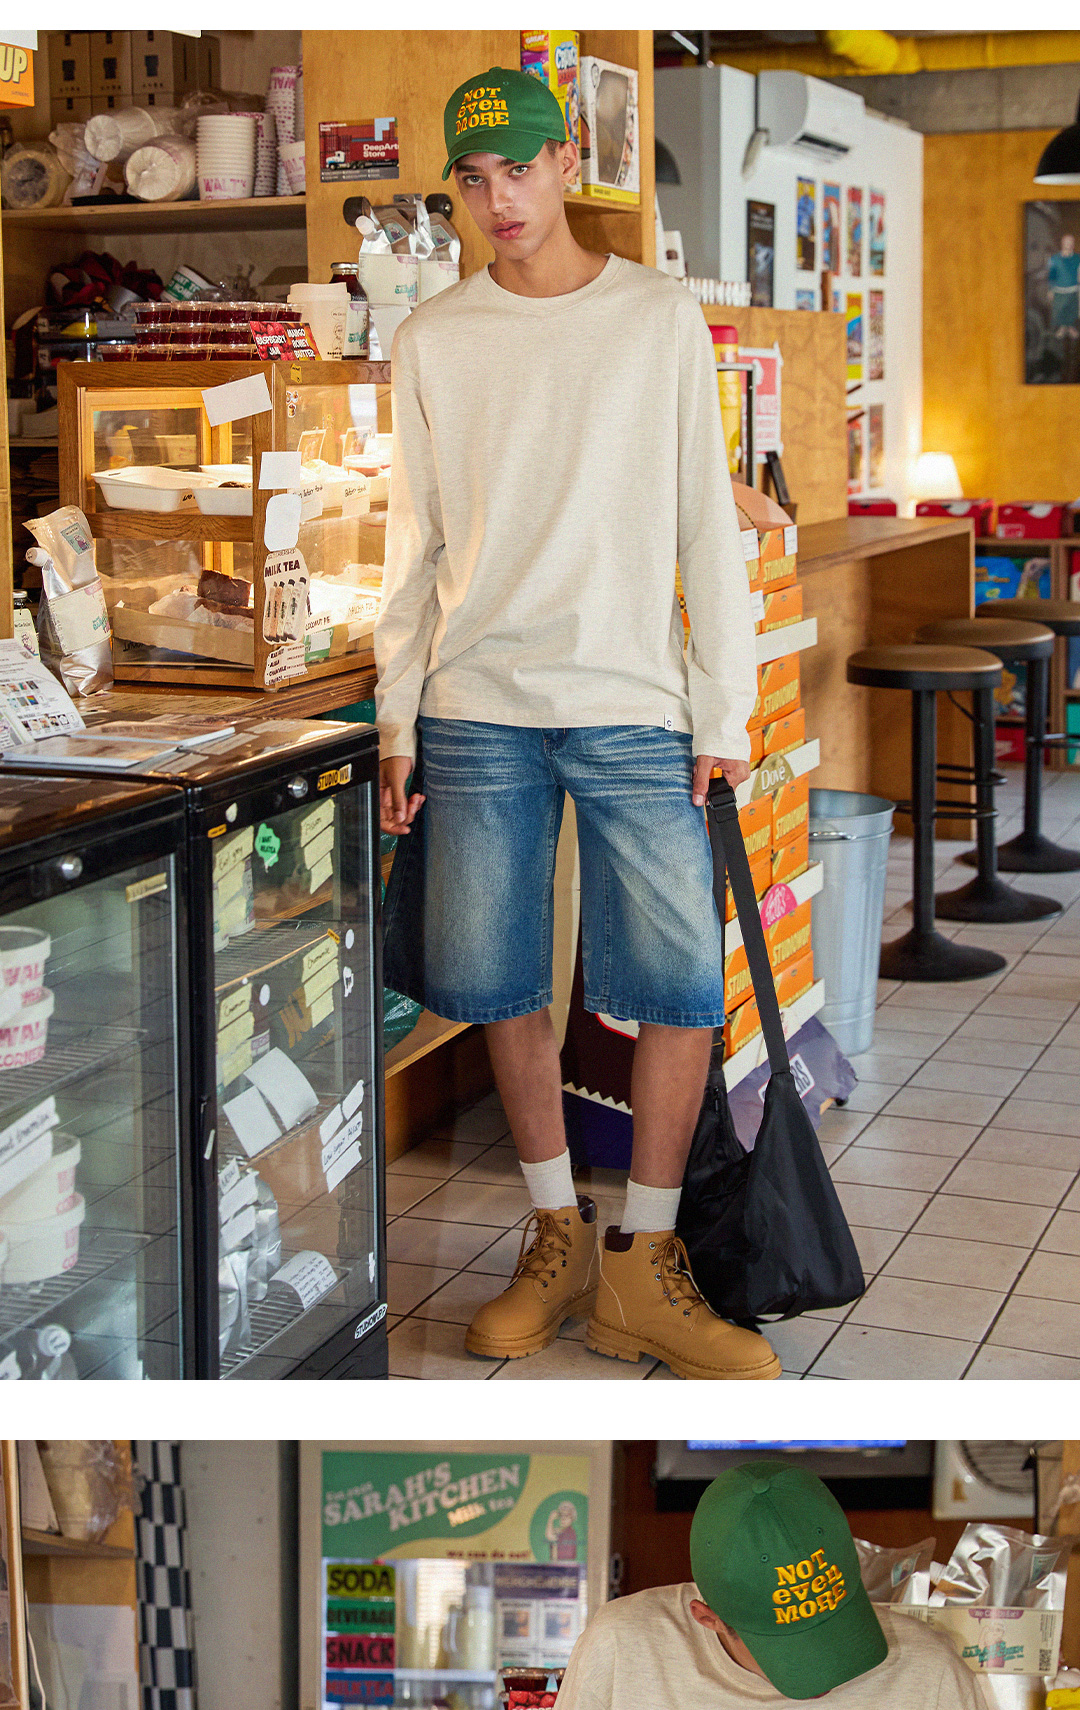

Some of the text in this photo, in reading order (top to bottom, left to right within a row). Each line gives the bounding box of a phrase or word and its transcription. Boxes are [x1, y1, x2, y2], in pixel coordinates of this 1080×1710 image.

[457, 99, 508, 118] even
[462, 87, 501, 105] NOT
[455, 111, 510, 136] MORE
[363, 150, 386, 158] Store
[265, 560, 300, 577] MILK TEA
[318, 770, 339, 790] STUDIO
[761, 765, 785, 790] Dove
[323, 1462, 452, 1527] SARAH'S
[389, 1464, 521, 1532] KITCHEN
[447, 1503, 486, 1528] Milk
[774, 1547, 825, 1586] NOT
[330, 1568, 392, 1592] SODA
[772, 1563, 843, 1605] even
[772, 1579, 847, 1625] MORE
[327, 1640, 393, 1665] SNACK
[326, 1679, 393, 1697] MILK TEA
